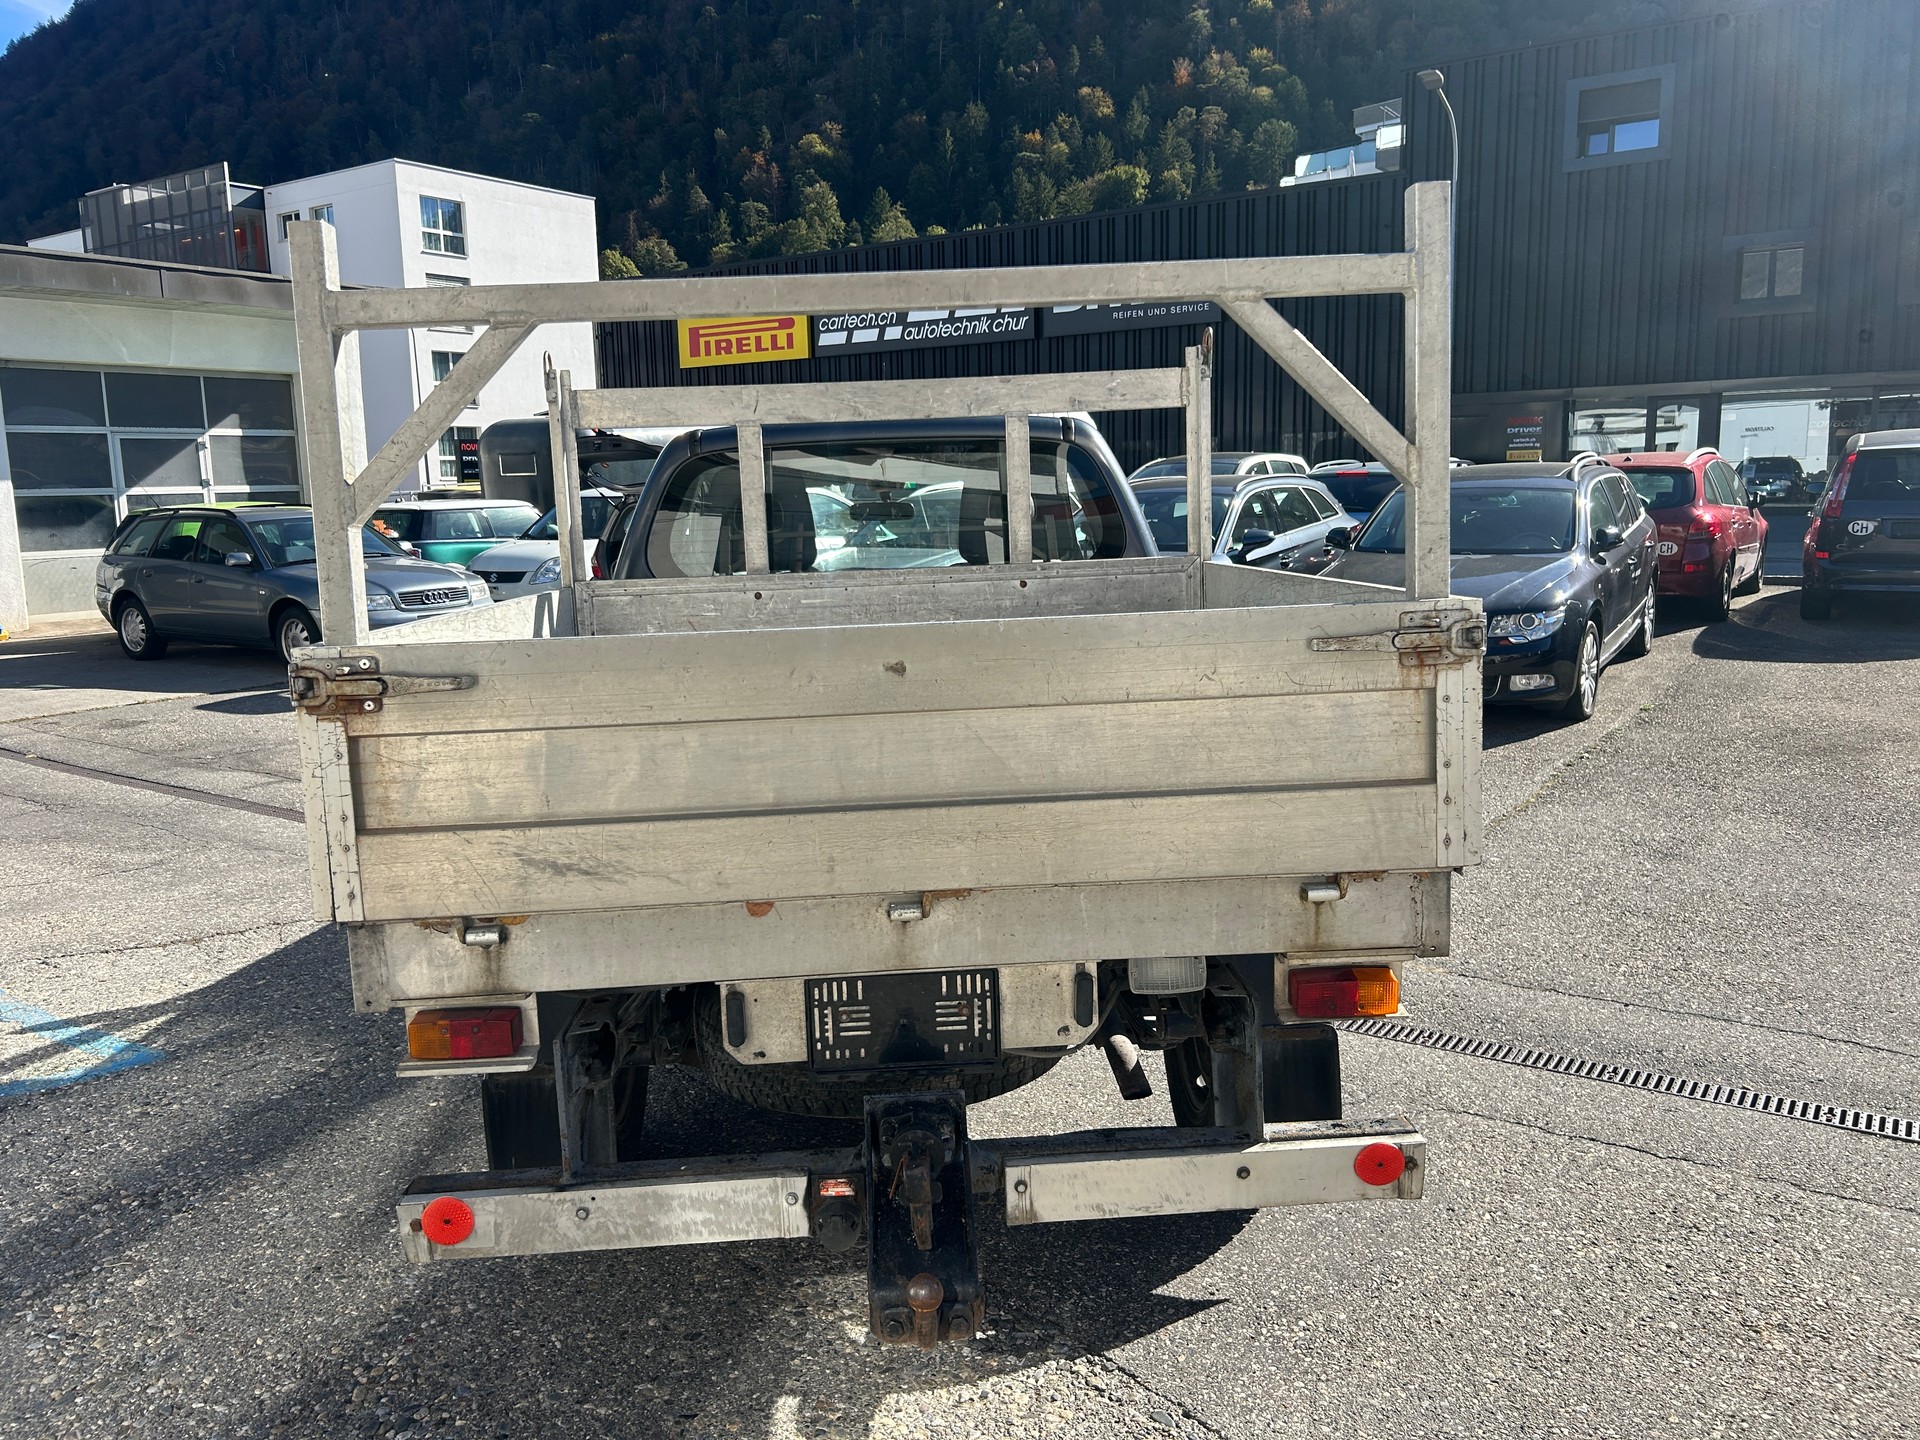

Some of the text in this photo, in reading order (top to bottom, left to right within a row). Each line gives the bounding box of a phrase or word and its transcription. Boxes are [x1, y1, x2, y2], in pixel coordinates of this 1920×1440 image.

[1112, 309, 1144, 319] REIFEN
[1147, 307, 1167, 316] UND
[1170, 303, 1210, 314] SERVICE
[904, 314, 1030, 341] autotechnik chur
[688, 316, 796, 358] PIRELLI
[1851, 521, 1870, 534] CH
[1659, 543, 1674, 554] CH
